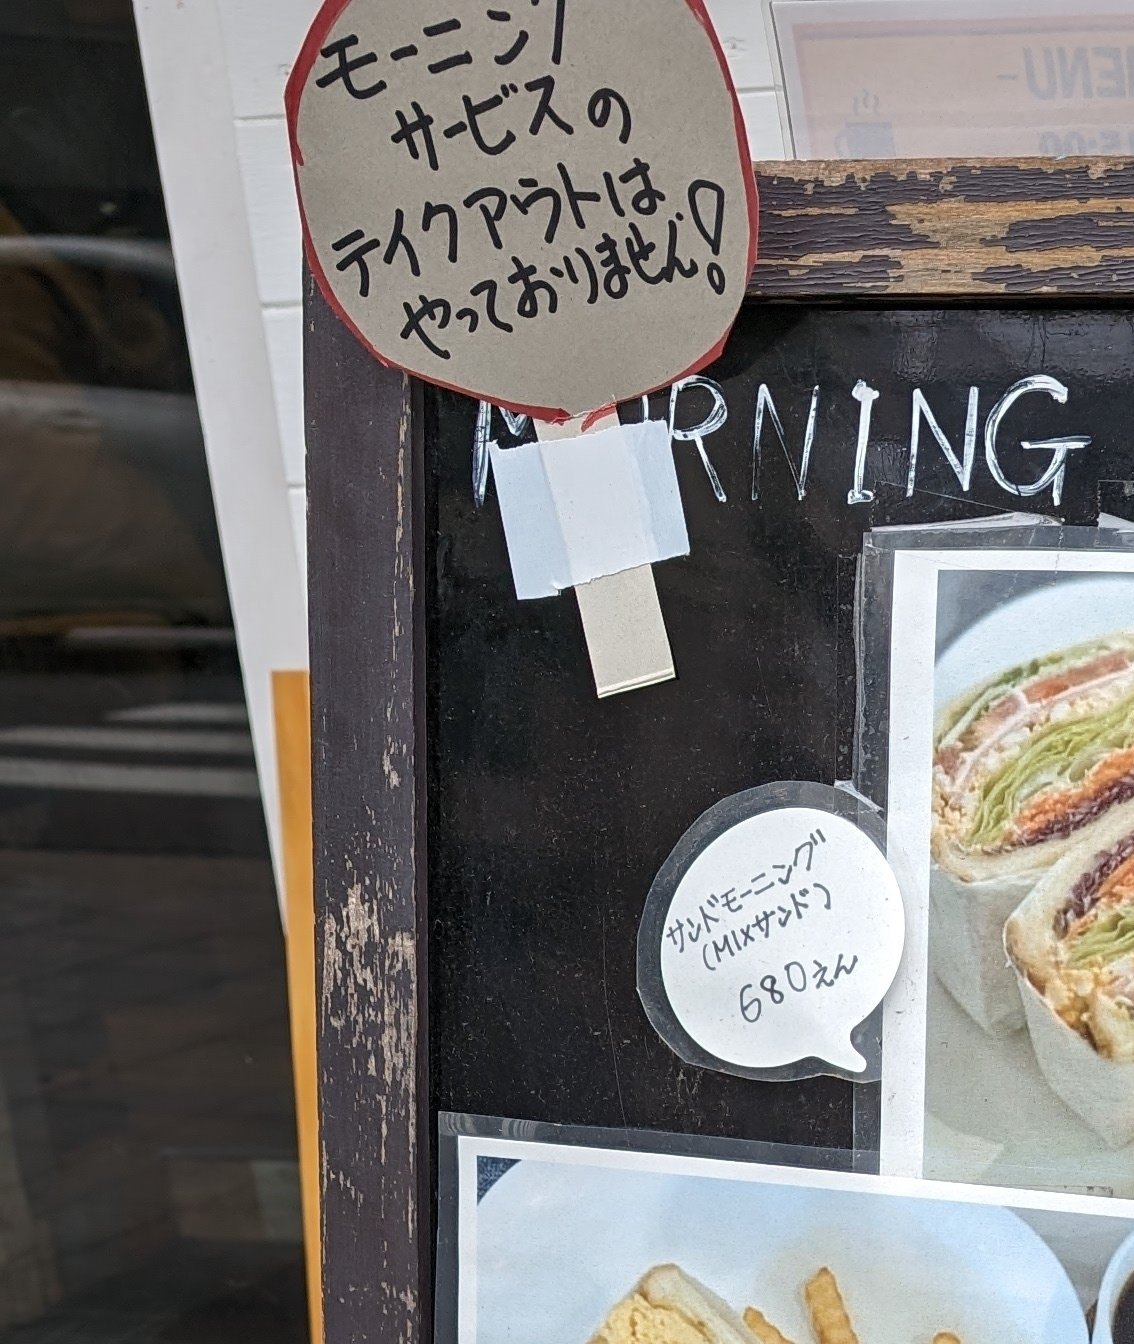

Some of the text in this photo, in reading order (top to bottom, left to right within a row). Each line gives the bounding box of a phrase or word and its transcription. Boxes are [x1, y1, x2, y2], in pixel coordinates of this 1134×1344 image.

[391, 75, 632, 171] サービスの
[333, 157, 667, 298] テイクアウトは
[470, 373, 1091, 508] MRNING
[666, 829, 827, 953] サンドモーニング
[739, 954, 858, 1023] 680えん
